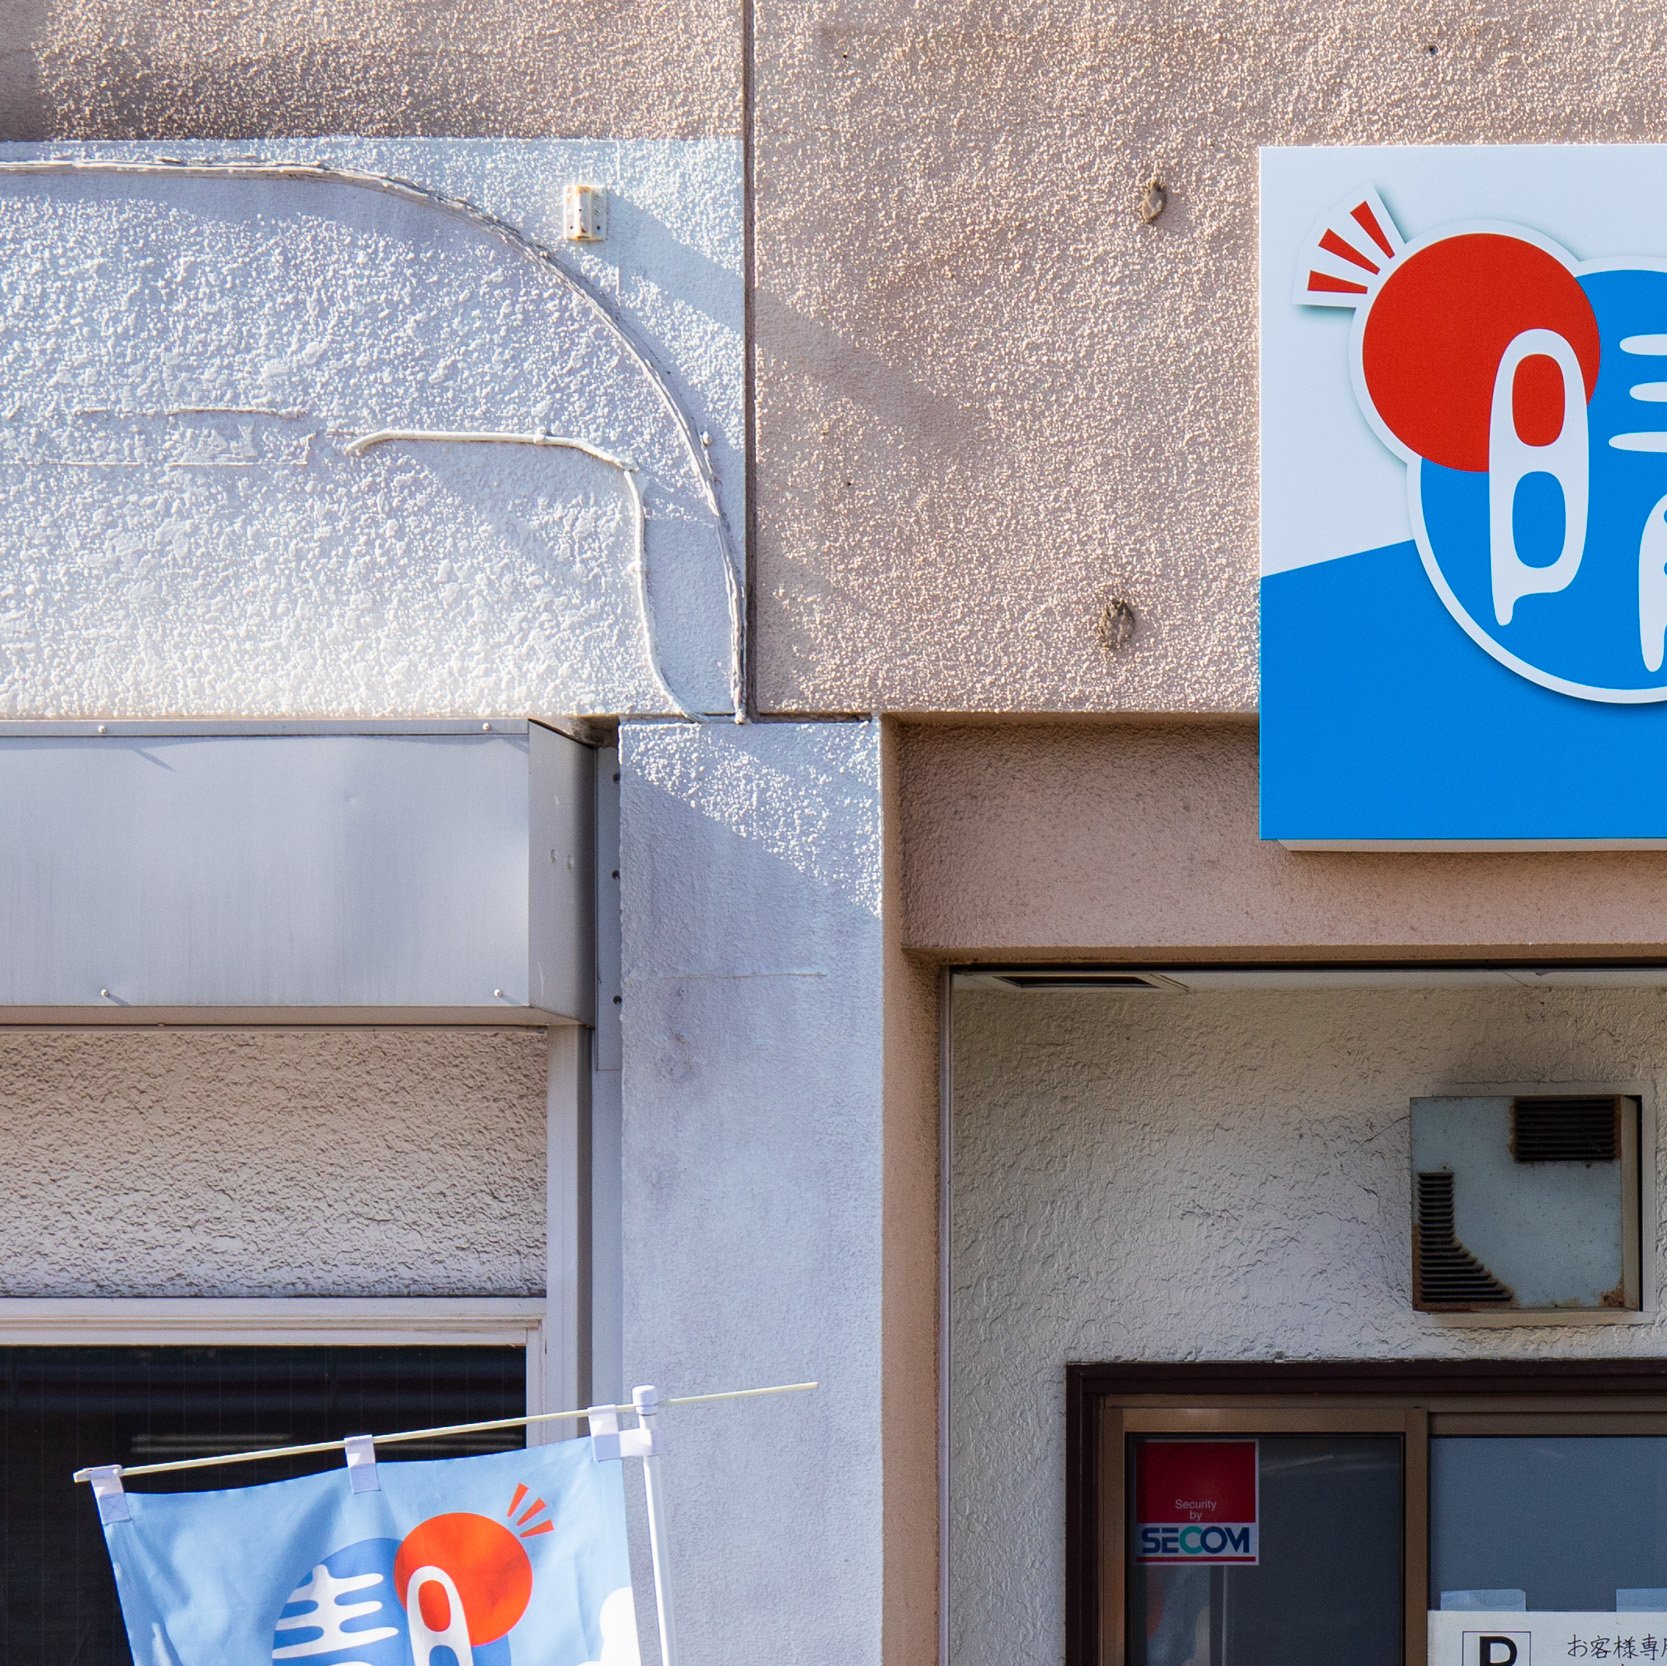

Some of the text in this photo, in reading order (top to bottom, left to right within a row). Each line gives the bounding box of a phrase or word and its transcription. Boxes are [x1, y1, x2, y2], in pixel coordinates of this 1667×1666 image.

[1175, 1499, 1217, 1511] Security
[1189, 1510, 1202, 1521] by
[1141, 1526, 1250, 1554] SECOM
